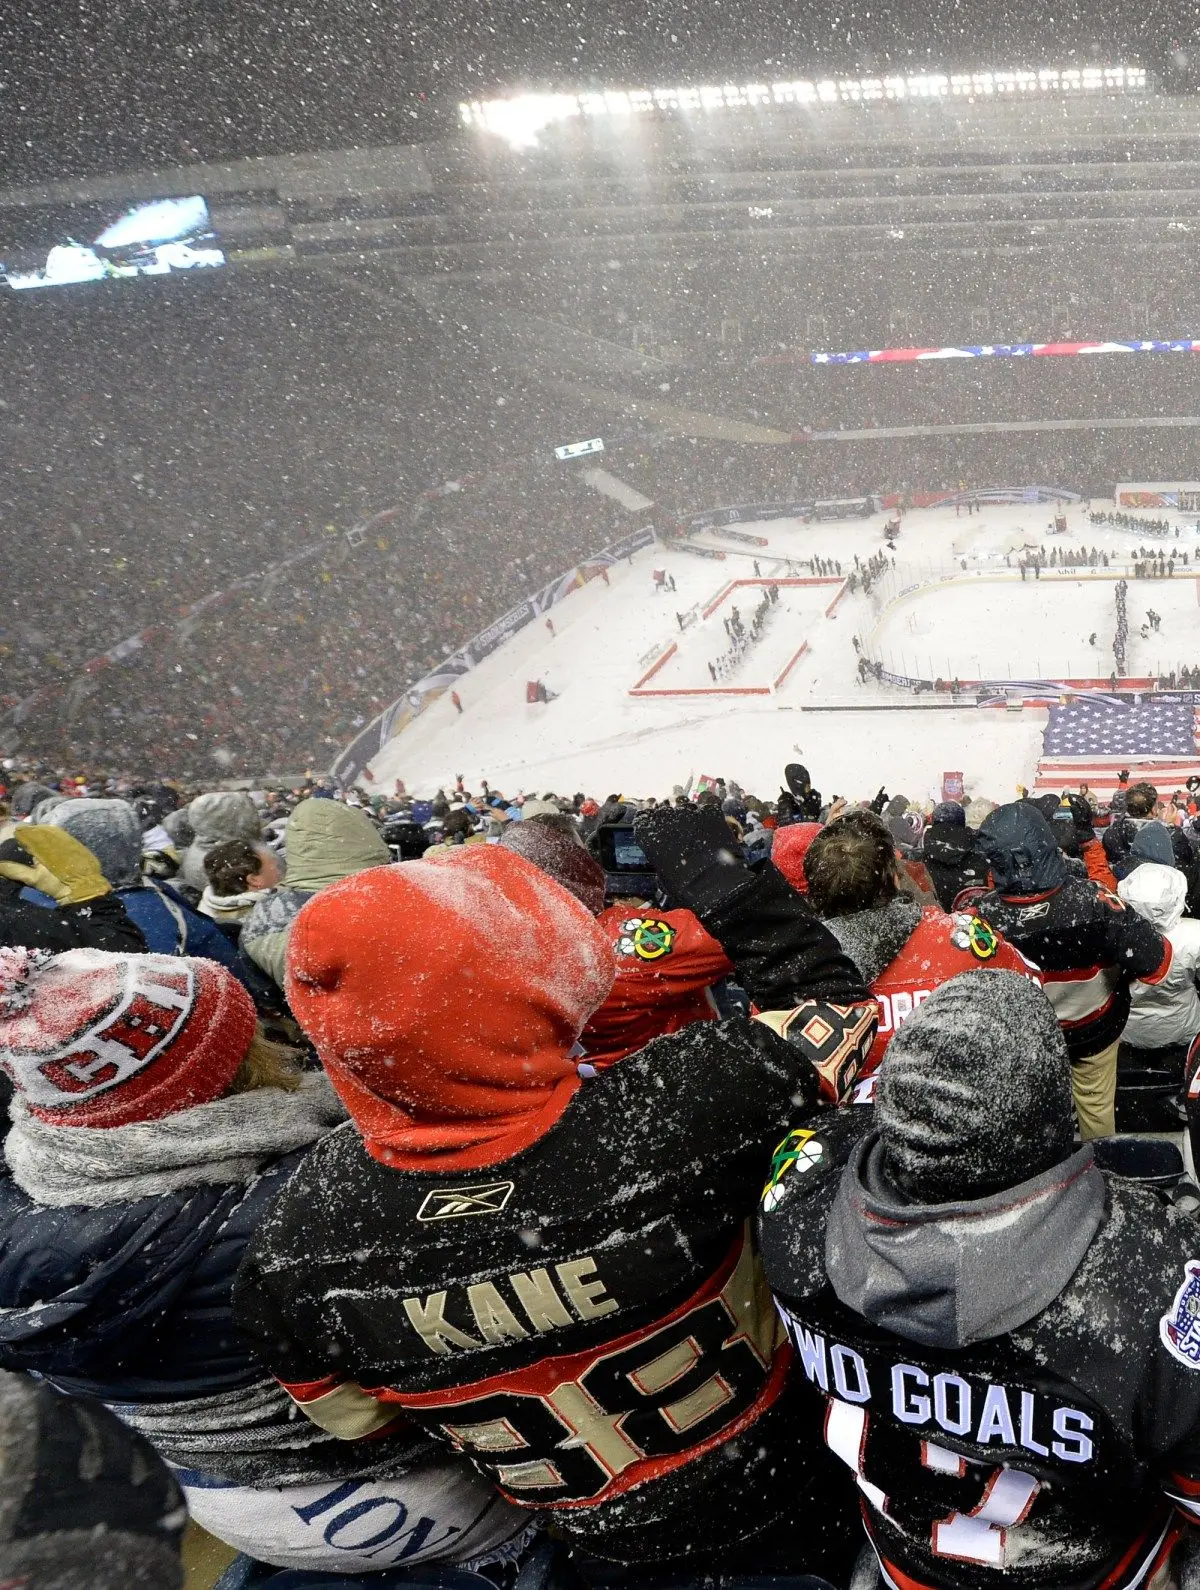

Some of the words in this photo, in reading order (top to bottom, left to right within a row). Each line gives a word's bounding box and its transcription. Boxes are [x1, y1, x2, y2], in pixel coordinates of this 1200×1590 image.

[402, 1256, 620, 1356] KANE
[400, 1295, 770, 1506] 88
[890, 1362, 1095, 1464] GOALS
